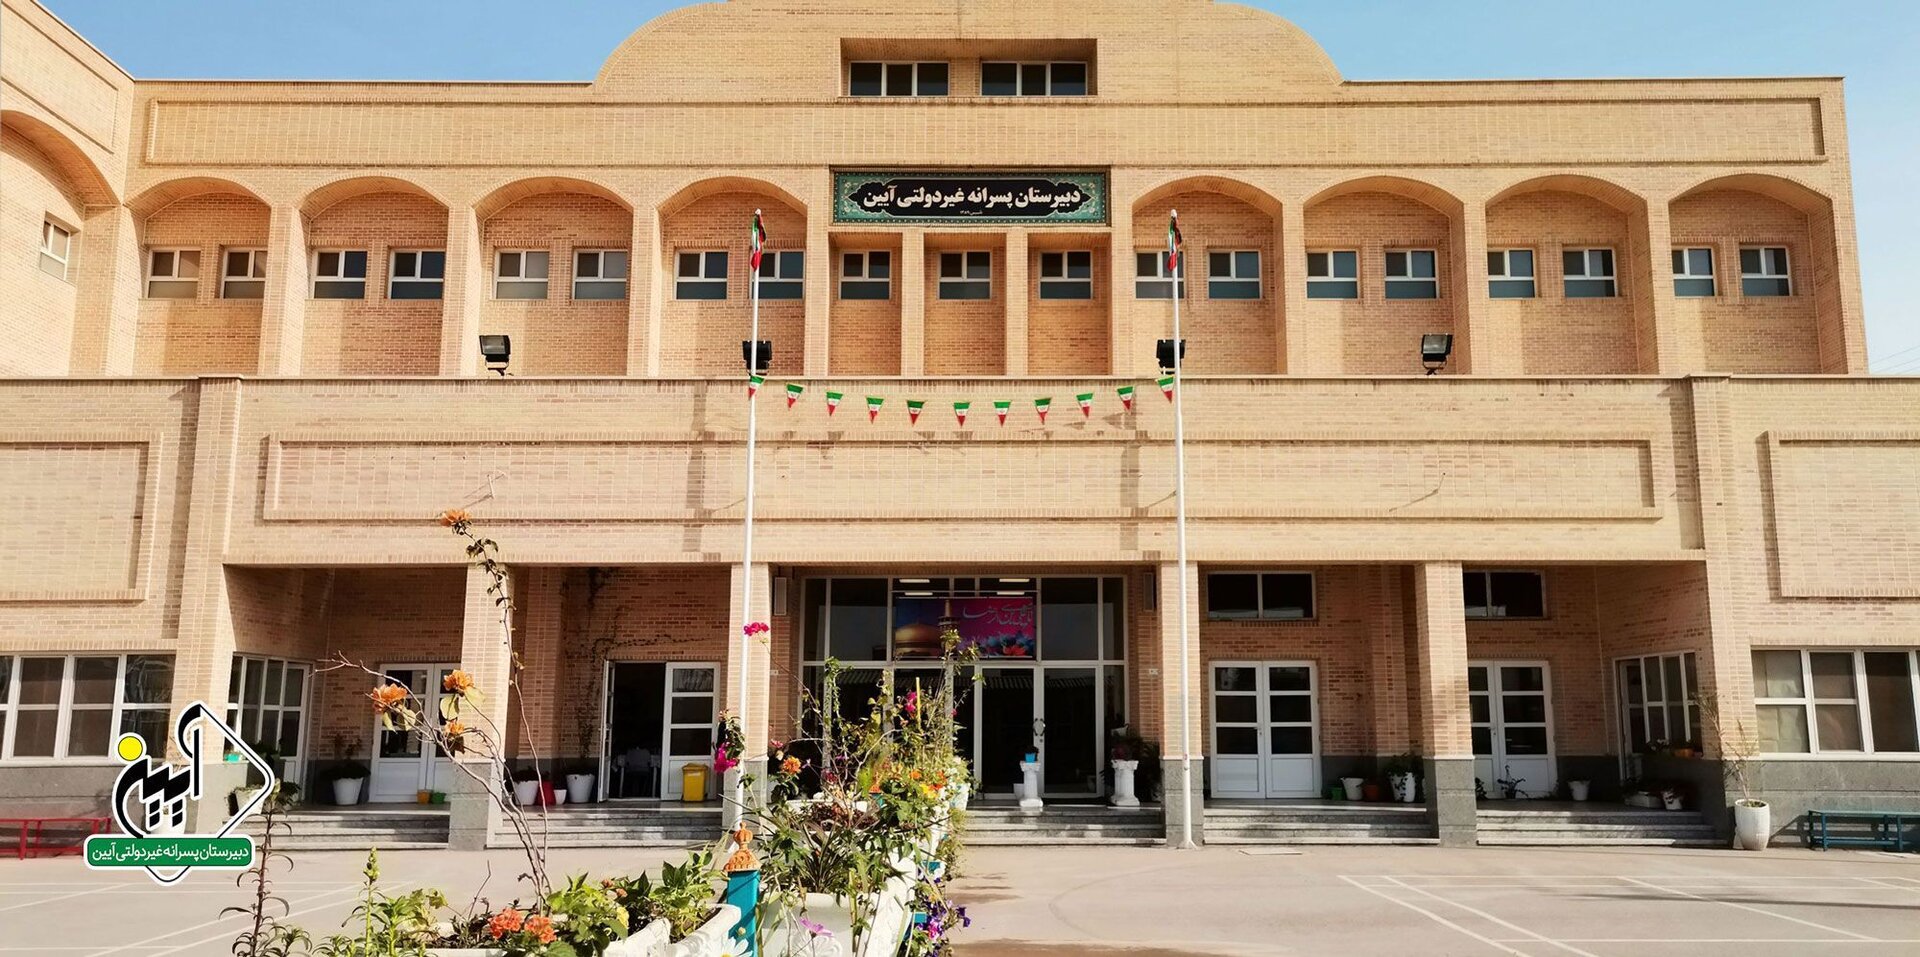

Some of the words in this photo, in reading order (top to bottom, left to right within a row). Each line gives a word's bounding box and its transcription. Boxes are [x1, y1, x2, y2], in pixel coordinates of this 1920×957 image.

[863, 184, 898, 208] آیین
[897, 186, 965, 208] غیردولتی
[967, 187, 1013, 209] پسرانه
[1014, 187, 1081, 208] دبیرستان
